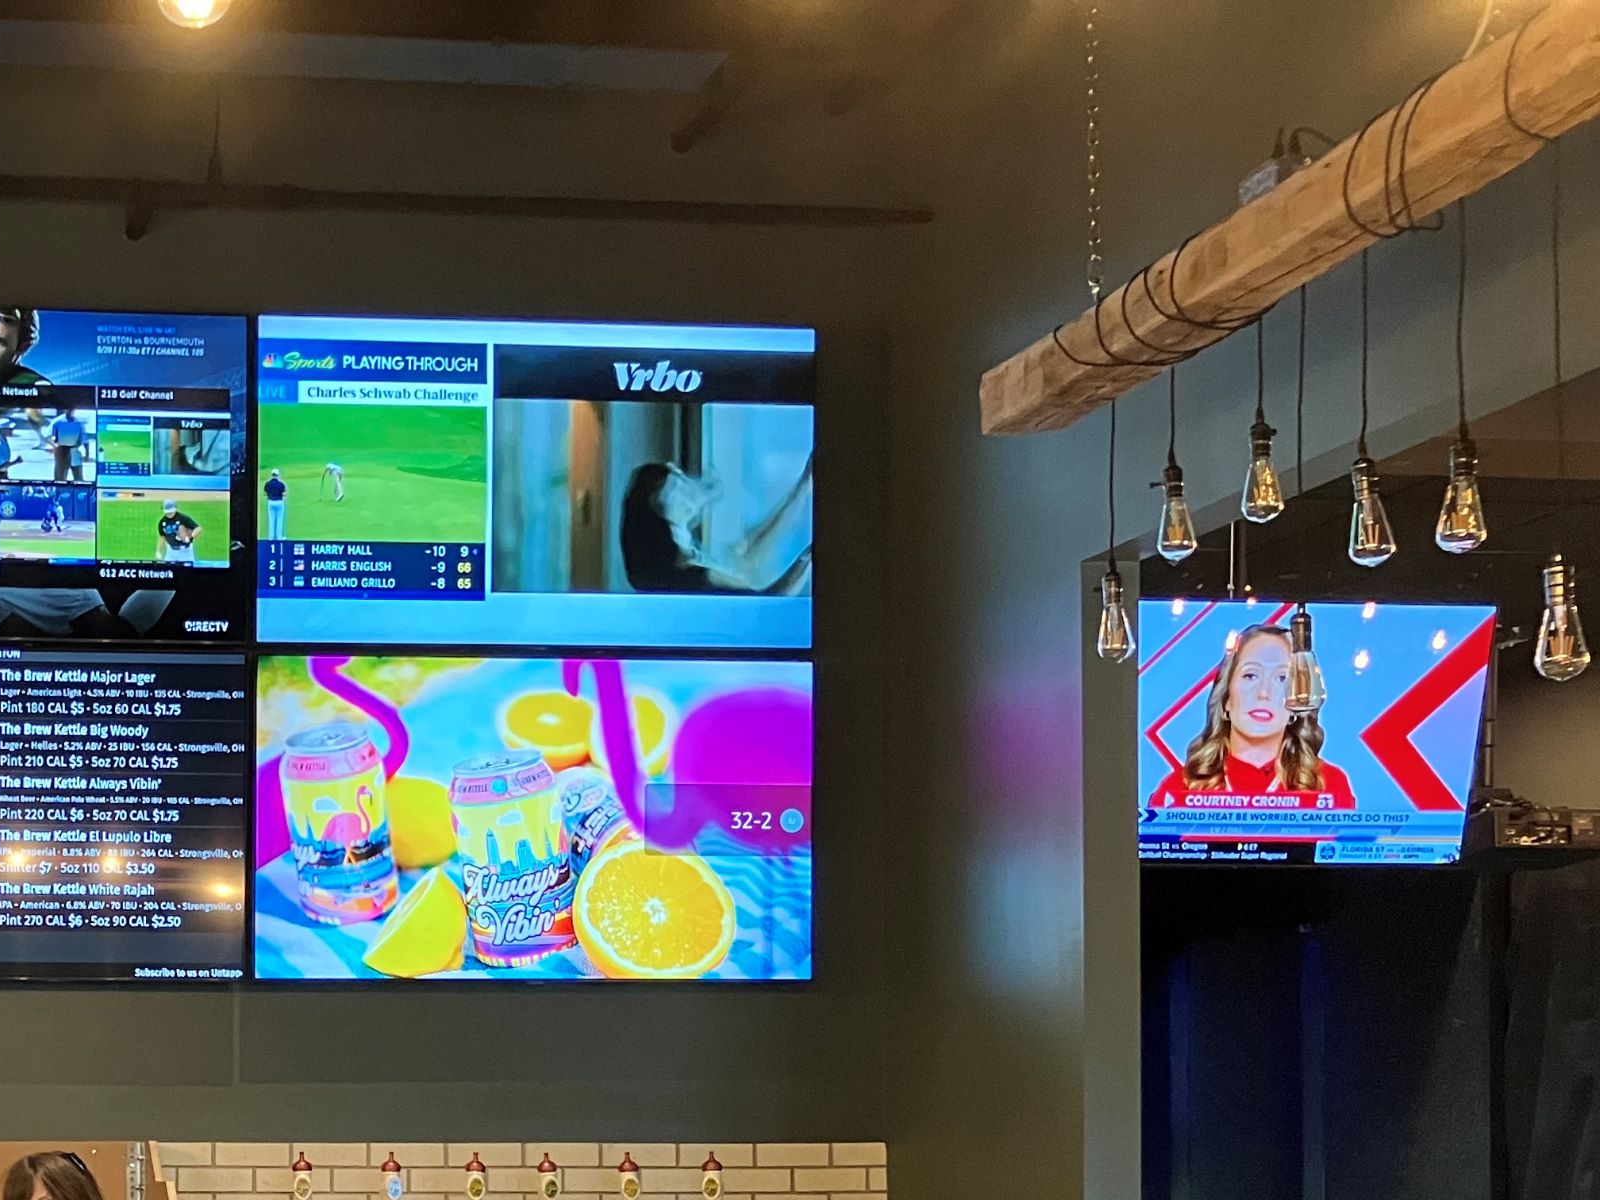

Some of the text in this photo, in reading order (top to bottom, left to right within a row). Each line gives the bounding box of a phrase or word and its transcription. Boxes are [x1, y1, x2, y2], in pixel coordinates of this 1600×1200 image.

[284, 352, 478, 372] Sports PLAYING THROUGH
[613, 359, 702, 394] Vrbo
[2, 387, 38, 397] Network
[101, 389, 174, 400] 218 Golf Channel
[259, 385, 286, 398] LIVE
[307, 386, 478, 403] Charles Schwab Challenge
[271, 545, 469, 557] 1 HARRY HALL -10 9
[100, 569, 173, 579] 612 ACC Network
[269, 560, 471, 574] 2 HARRIS ENGLISH -9 66
[269, 577, 471, 589] 3 EMILIANO GRILLO -8 65
[185, 621, 229, 632] DIRECTV
[0, 669, 156, 685] The Brew Kettle Major Lager
[0, 702, 181, 717] Pint 180 CAL $5 5oz 60 CAL $1.75
[1185, 794, 1250, 807] COURTNEY
[1251, 795, 1300, 808] CRONIN
[731, 811, 772, 831] 32-2
[1165, 811, 1410, 824] SHOULD HEAT BE WORRIED, CAN CELTICS DO THIS?
[463, 863, 559, 906] Always
[475, 897, 560, 946] Vibin'
